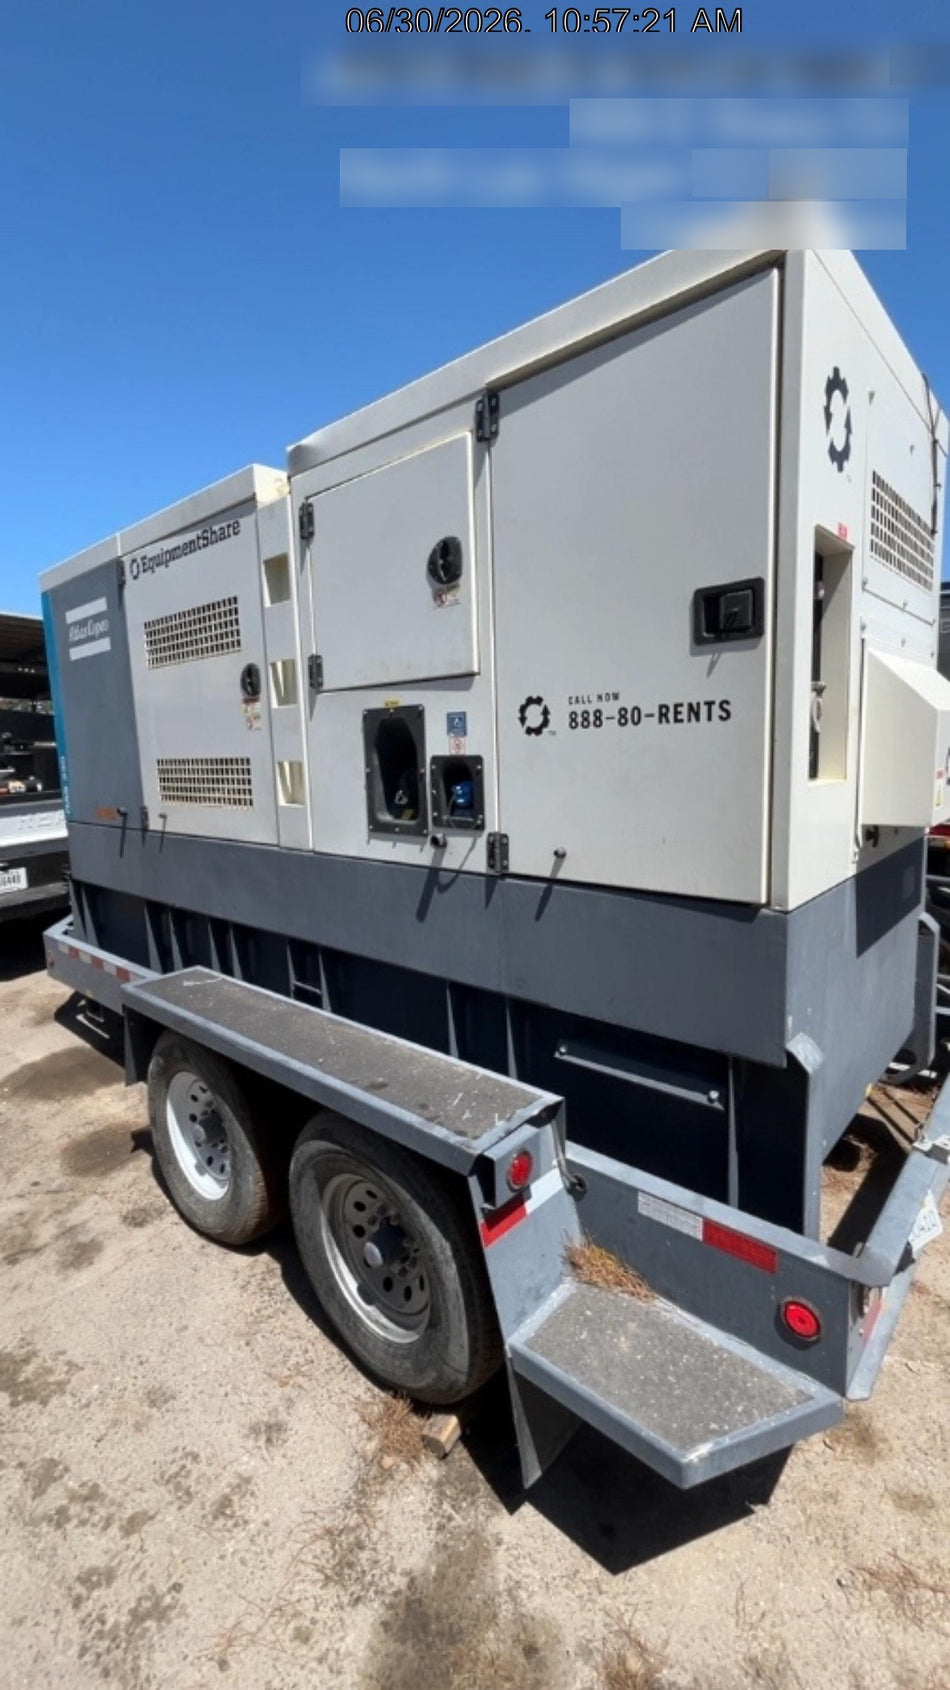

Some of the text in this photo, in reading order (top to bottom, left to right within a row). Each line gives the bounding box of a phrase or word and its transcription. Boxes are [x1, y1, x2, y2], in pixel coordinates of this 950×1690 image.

[140, 519, 241, 573] EquipmentShare
[568, 692, 621, 705] CALL NOW
[568, 699, 732, 730] 888-80-RENTS
